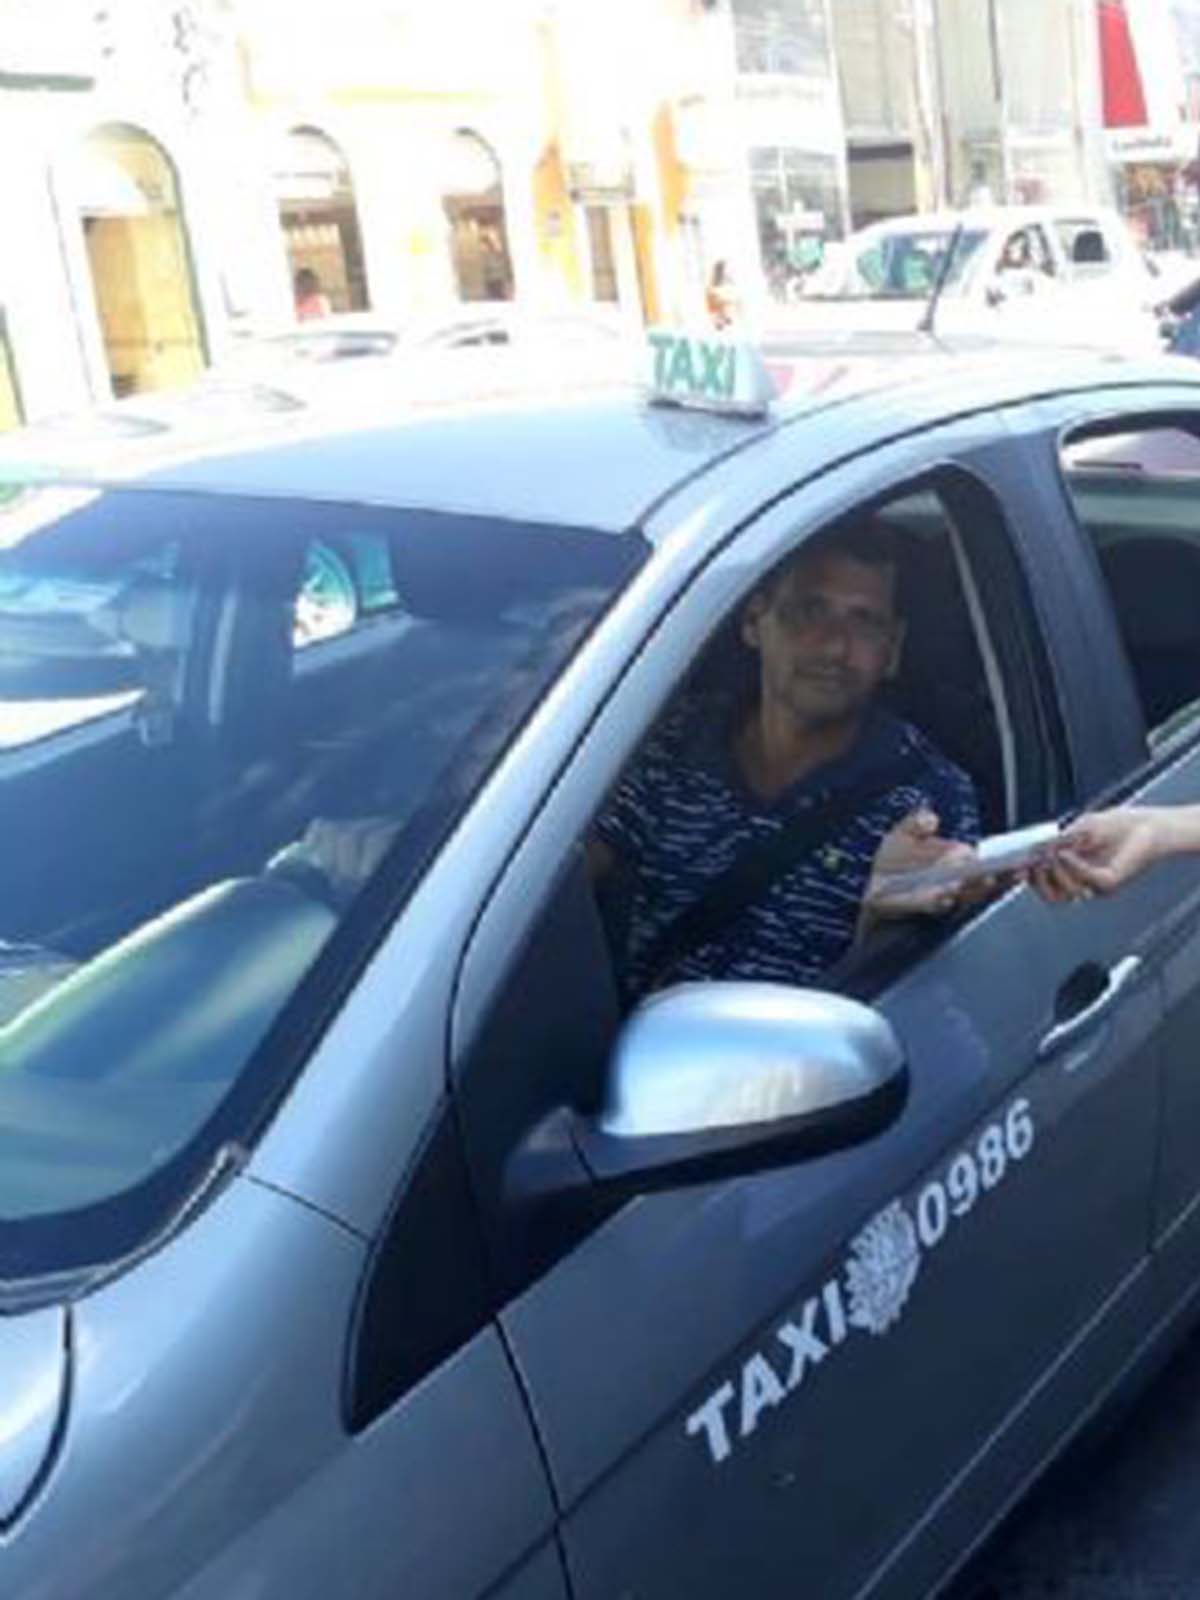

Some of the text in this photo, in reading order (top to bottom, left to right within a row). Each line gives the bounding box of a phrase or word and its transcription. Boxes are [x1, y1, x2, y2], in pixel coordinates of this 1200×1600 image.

[647, 334, 736, 398] TAXI
[686, 1098, 1034, 1462] TAXI 0986
